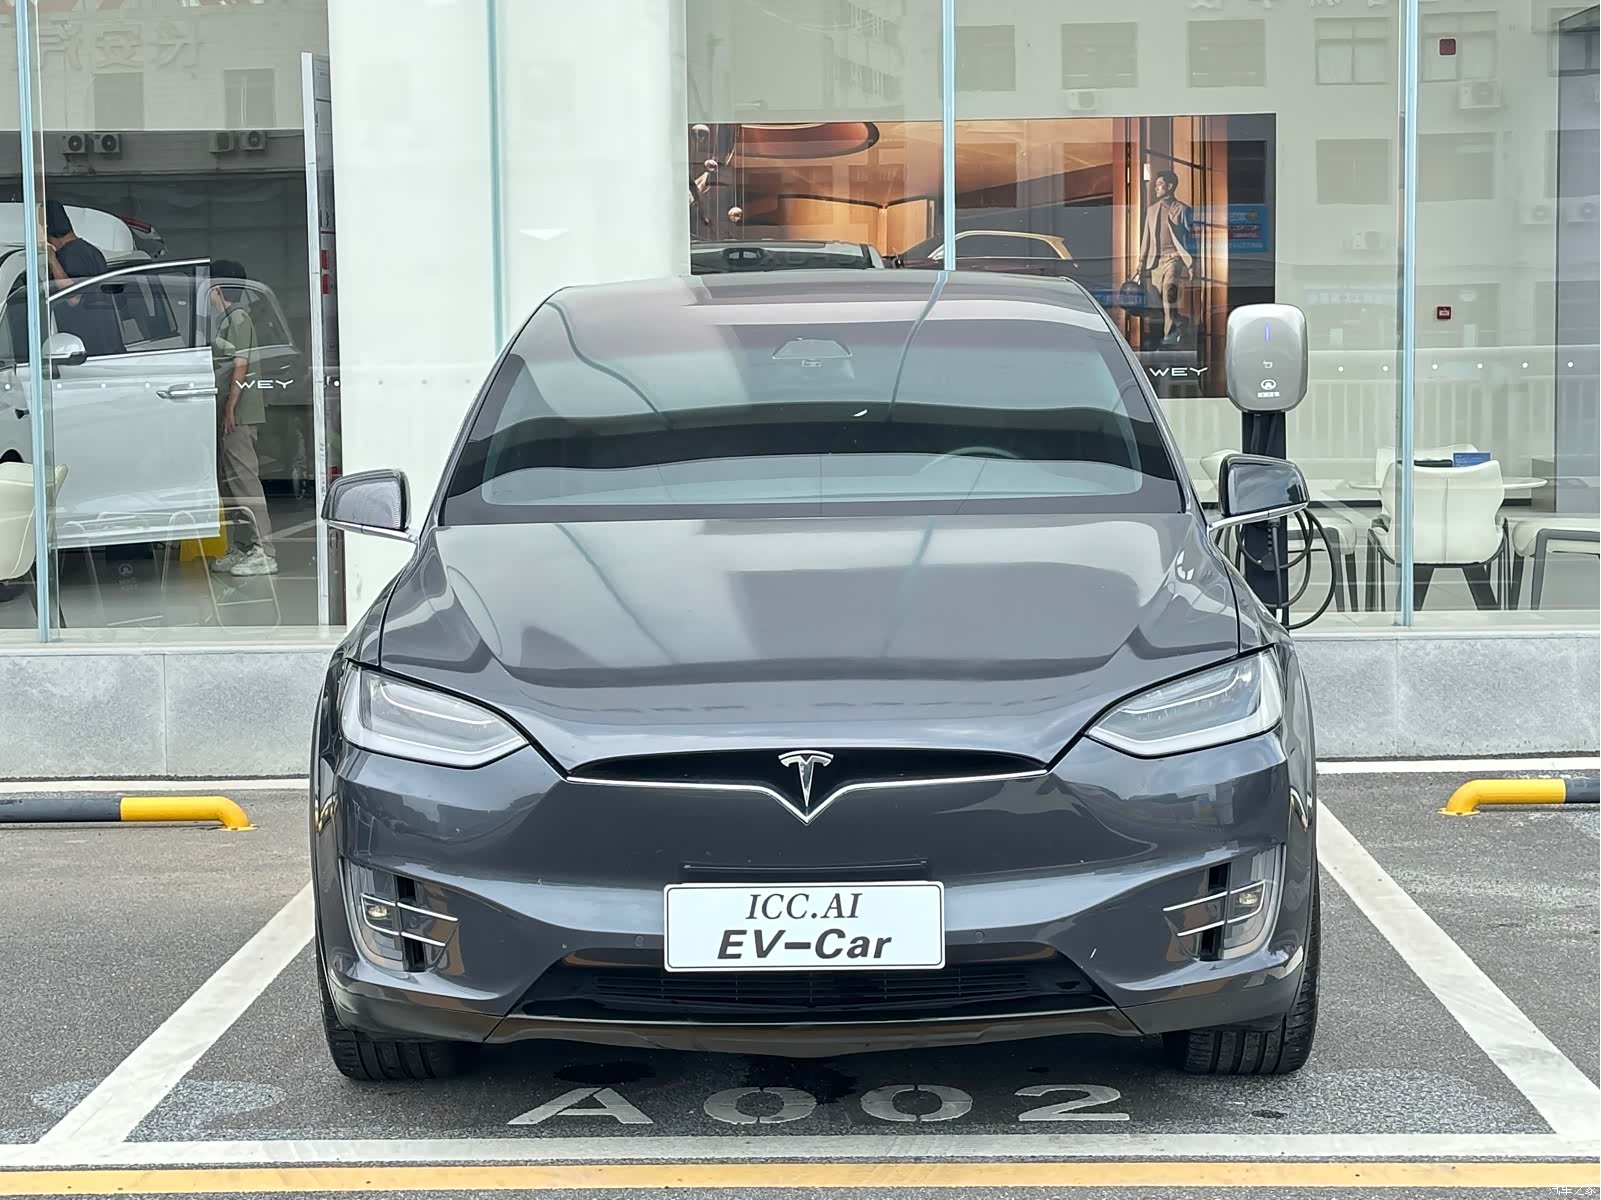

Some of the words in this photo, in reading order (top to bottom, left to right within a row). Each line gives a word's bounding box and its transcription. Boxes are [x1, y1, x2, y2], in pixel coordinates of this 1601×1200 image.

[235, 379, 294, 389] WEY
[1149, 366, 1208, 377] WEY
[745, 893, 863, 920] ICC.AI
[717, 928, 892, 960] EV-Car
[506, 1084, 1130, 1125] A002
